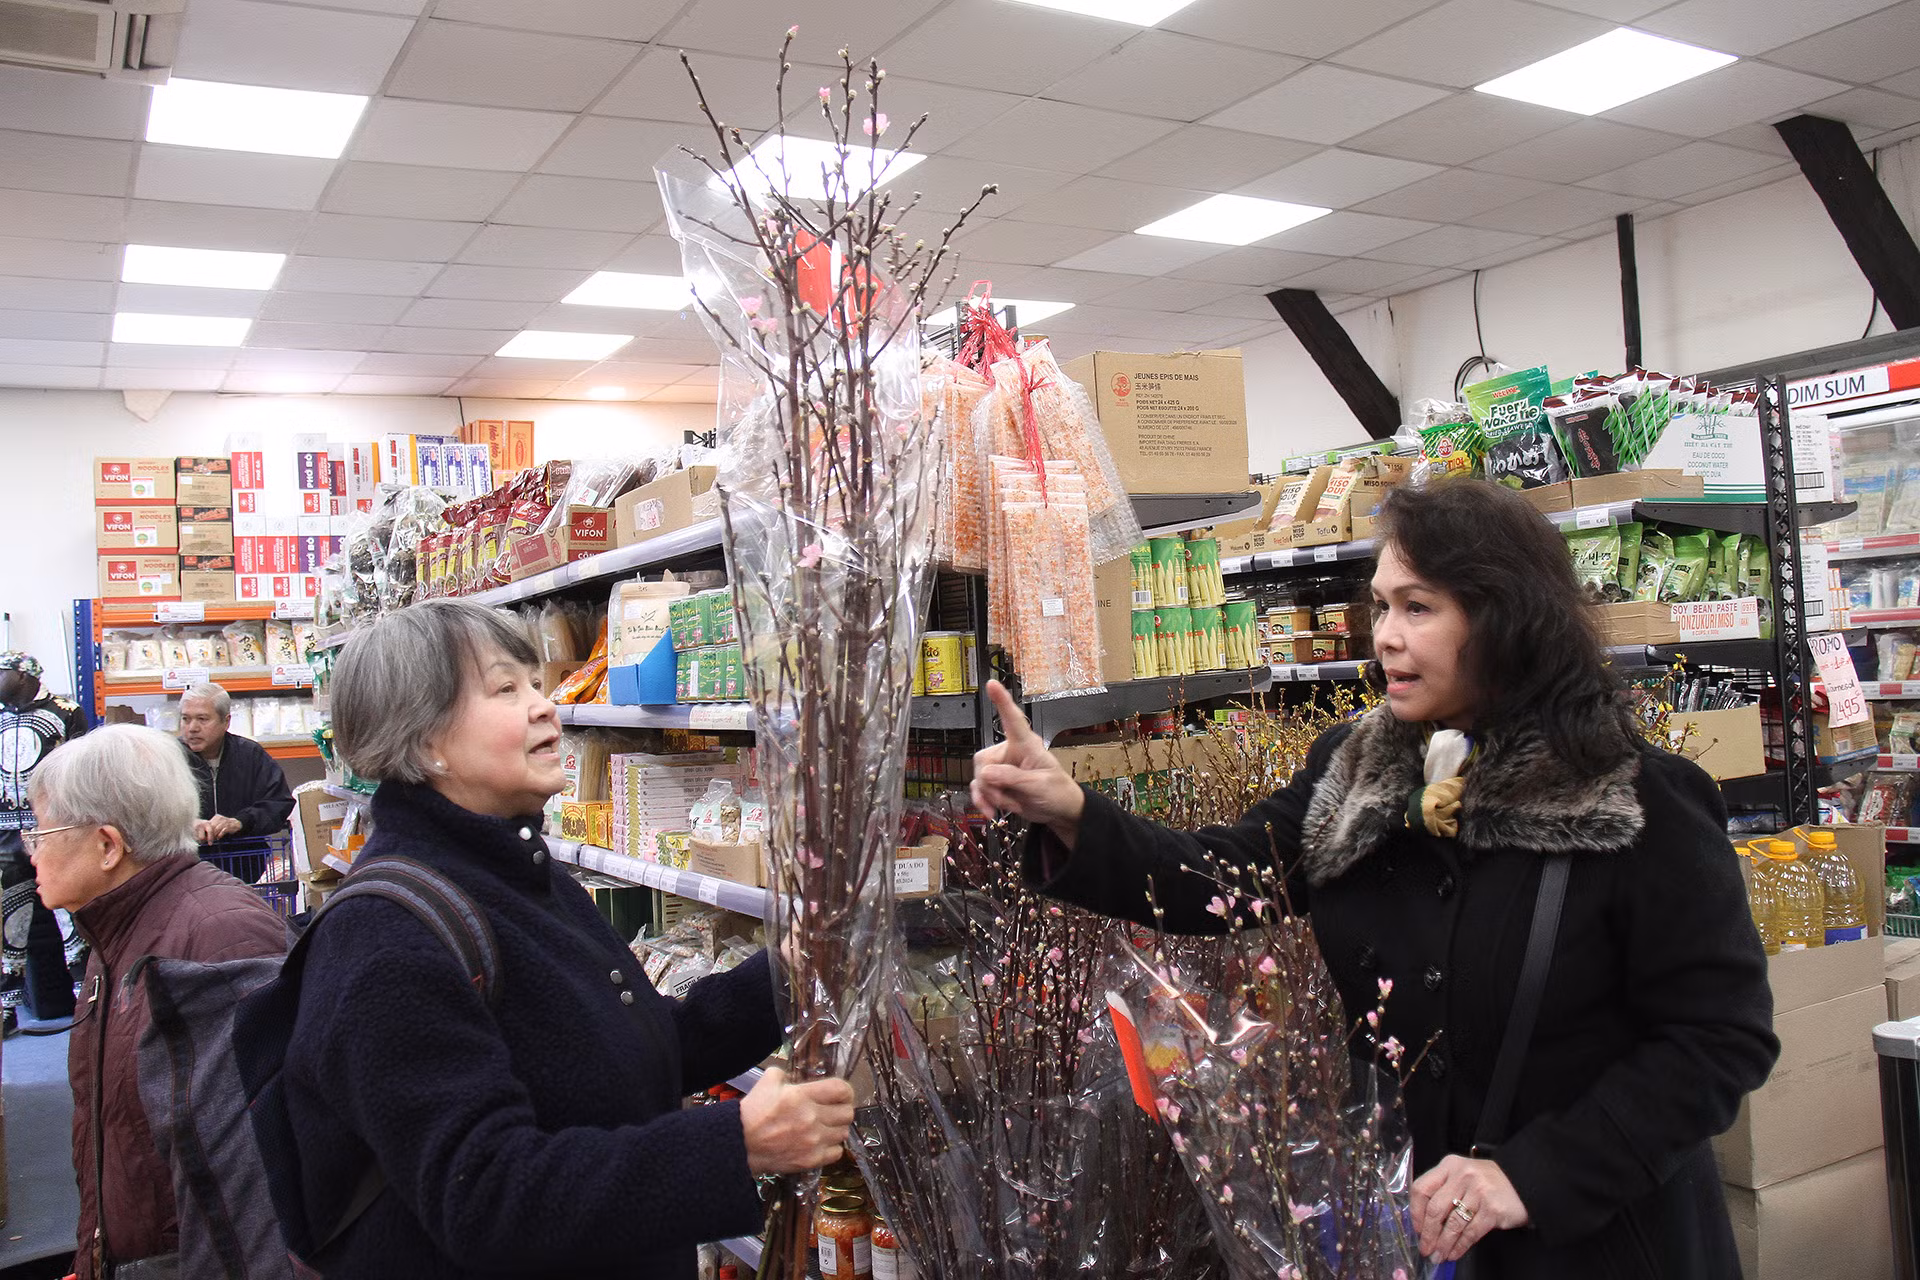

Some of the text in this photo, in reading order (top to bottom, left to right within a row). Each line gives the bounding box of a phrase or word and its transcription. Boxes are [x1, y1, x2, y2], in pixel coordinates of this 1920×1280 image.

[1787, 375, 1865, 404] DIM SUM
[575, 529, 604, 538] VIFON
[1673, 603, 1738, 614] SOY BEAN PASTE
[1676, 613, 1734, 631] HONZUKURI MISO
